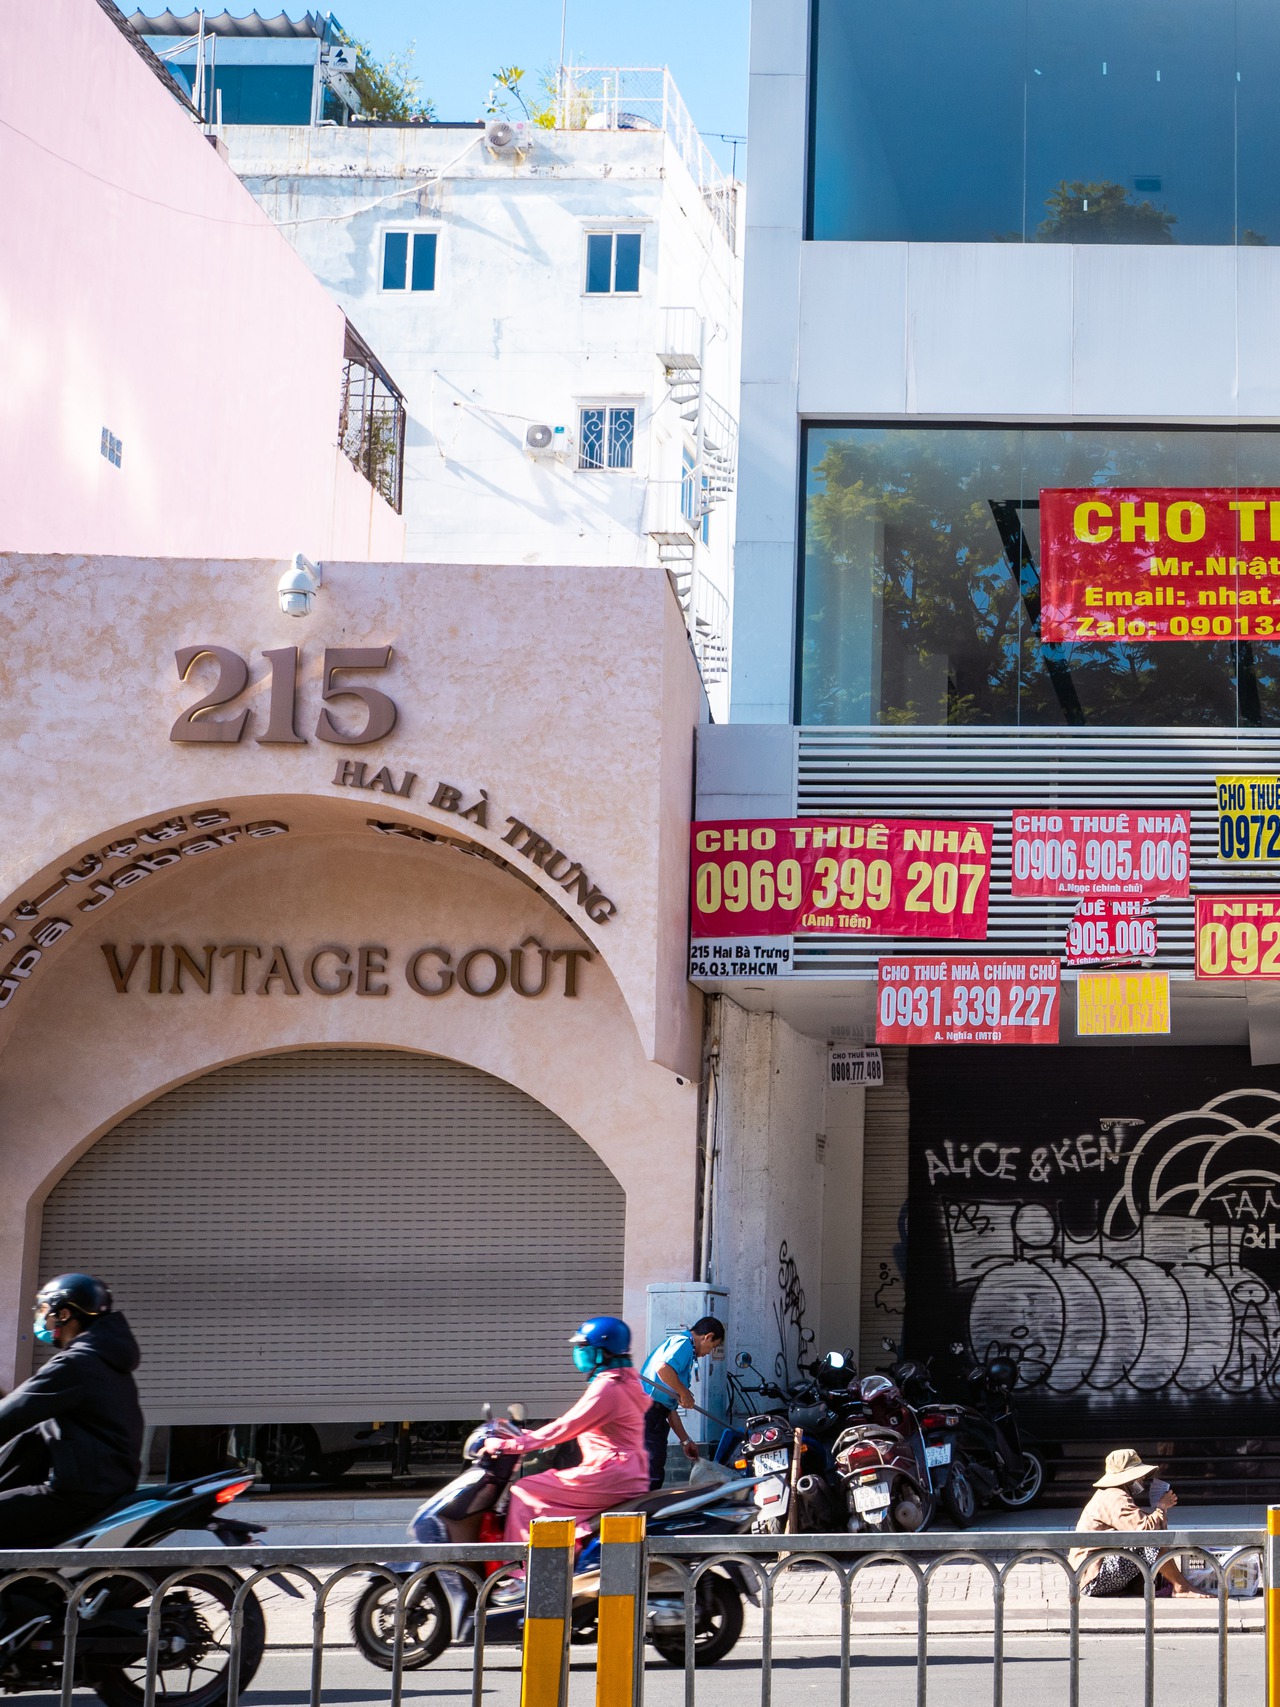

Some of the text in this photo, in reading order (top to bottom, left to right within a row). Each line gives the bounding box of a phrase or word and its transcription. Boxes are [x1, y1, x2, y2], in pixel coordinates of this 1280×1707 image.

[1073, 501, 1206, 543] CHO
[1150, 556, 1280, 579] Mr.Nhật
[1085, 587, 1185, 606] Email:
[1076, 617, 1157, 636] Zalo:
[169, 644, 397, 745] 215
[1219, 784, 1245, 811] CHO
[1015, 814, 1187, 833] CHO THUÊ NHÀ
[332, 758, 417, 798] HAI
[427, 789, 488, 829] BÀ
[500, 815, 617, 925] TRƯNG
[696, 824, 986, 854] CHO THUÊ NHÀ
[77, 820, 289, 912] Jabara
[1014, 839, 1187, 881] 0906.905.006
[696, 857, 986, 914] 0969 399 207
[1093, 883, 1121, 893] (chính
[802, 914, 834, 927] (Anh
[101, 936, 593, 997] VINTAGE GOÛT
[691, 943, 790, 962] 215 Hai Bà Trưng
[882, 965, 910, 981] CHO
[914, 962, 947, 981] THUÊ
[952, 962, 980, 980] NHÀ
[984, 961, 1025, 980] CHÍNH
[1030, 960, 1057, 980] CHỦ
[1079, 972, 1168, 1004] NHÀ BÁN
[880, 985, 1057, 1027] 0931.339.227
[935, 1032, 944, 1040] A.
[975, 1031, 1002, 1041] (MTG)
